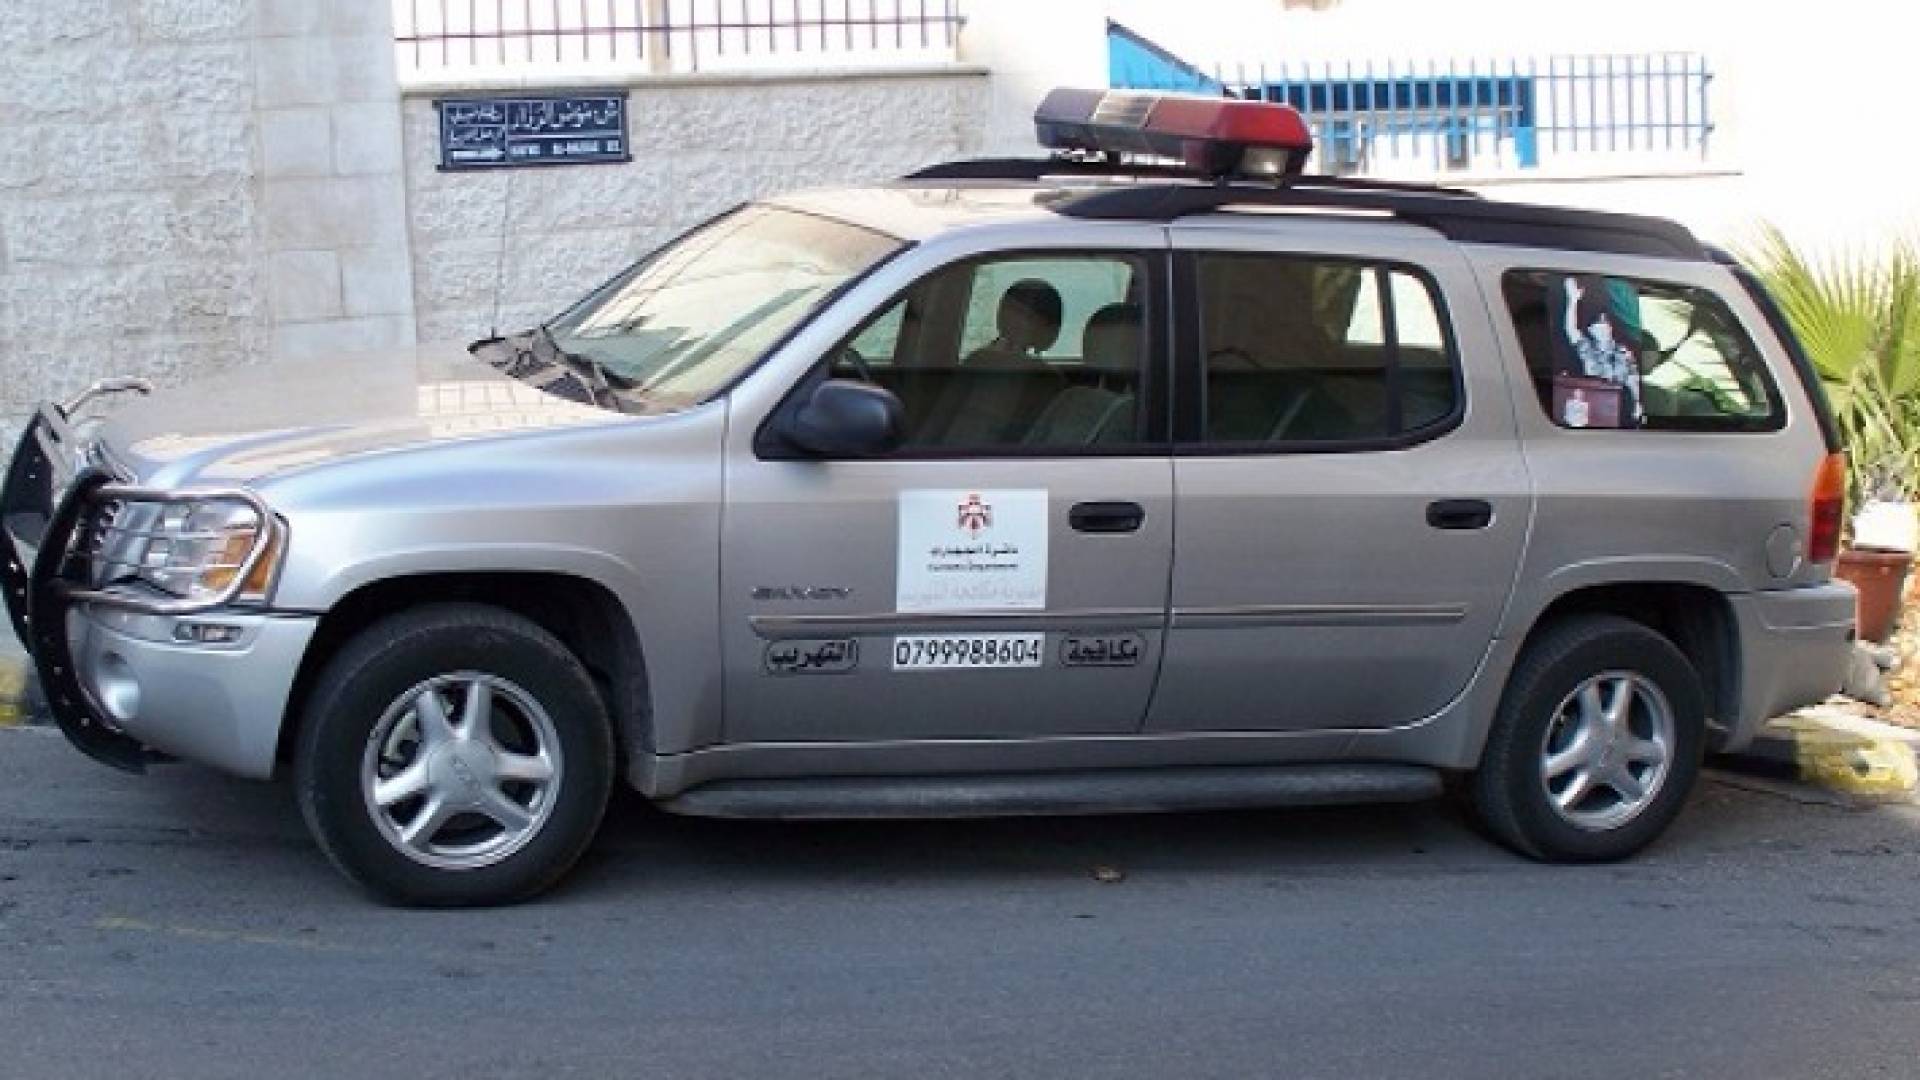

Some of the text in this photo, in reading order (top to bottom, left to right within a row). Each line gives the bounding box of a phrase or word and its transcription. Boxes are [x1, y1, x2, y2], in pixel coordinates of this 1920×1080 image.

[769, 638, 1138, 673] مكافحة التهريب
[896, 639, 1039, 665] 0799988604
